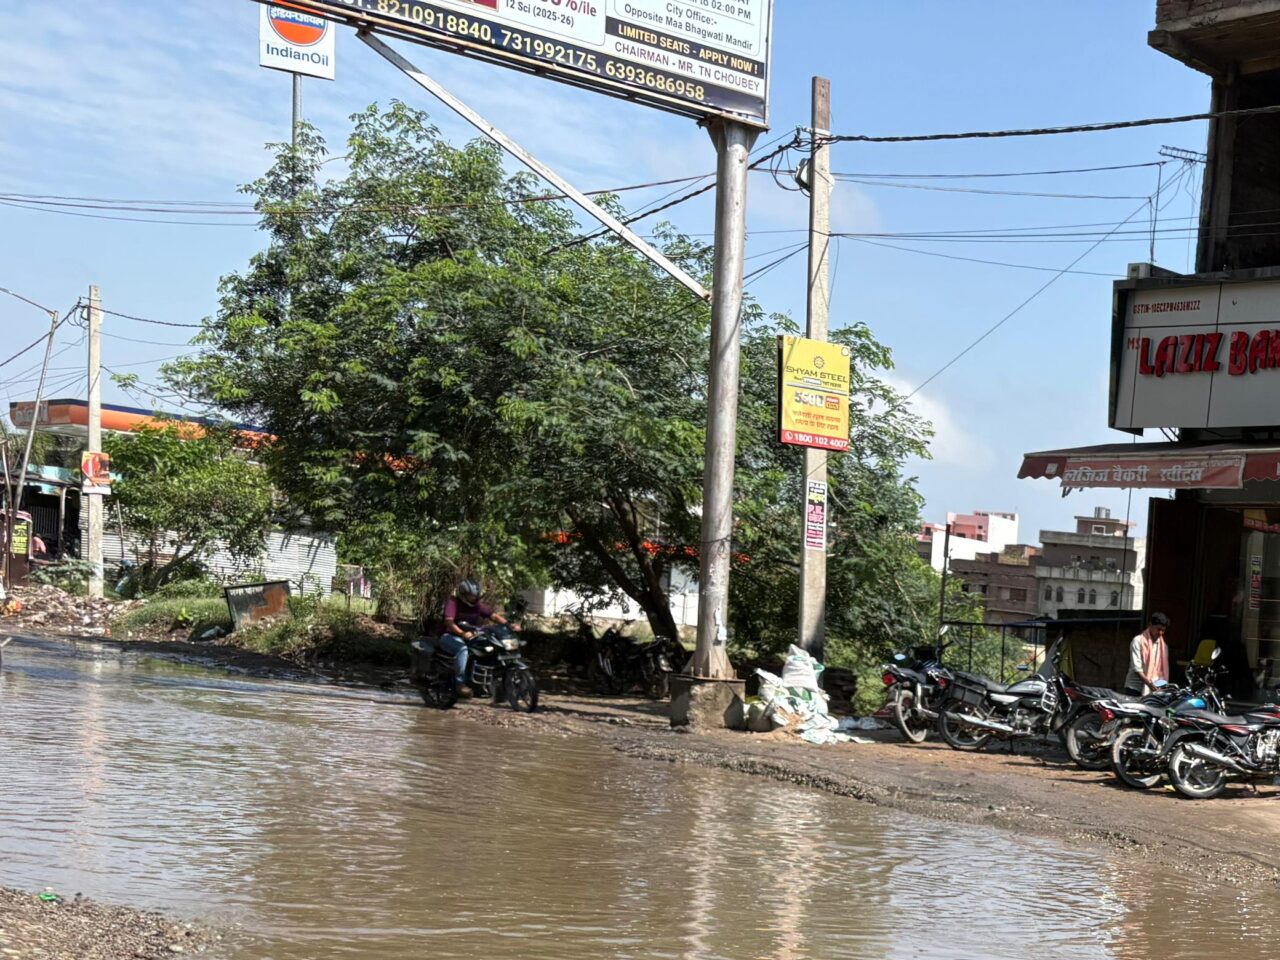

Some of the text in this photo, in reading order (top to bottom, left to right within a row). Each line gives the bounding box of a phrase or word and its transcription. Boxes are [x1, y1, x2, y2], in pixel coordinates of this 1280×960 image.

[517, 2, 531, 14] Sci
[532, 6, 575, 28] (2025-26)
[666, 3, 684, 18] City
[711, 0, 735, 15] 02:00
[737, 7, 751, 19] PM
[624, 3, 753, 50] Opposite Maa Bhagwati Mandir
[266, 43, 329, 67] IndianOil
[618, 23, 657, 45] LIMITED
[659, 37, 690, 54] SEATS
[699, 49, 729, 66] APPLY
[730, 57, 752, 73] NOW
[605, 60, 705, 101] 6393686958
[615, 41, 669, 66] CHAIRMAN
[678, 59, 696, 75] MR.
[698, 65, 711, 79] TN
[714, 69, 760, 92] CHOUBEY
[1139, 331, 1225, 378] LAZIZ
[785, 366, 818, 378] SHYAM
[819, 371, 849, 383] STEEL
